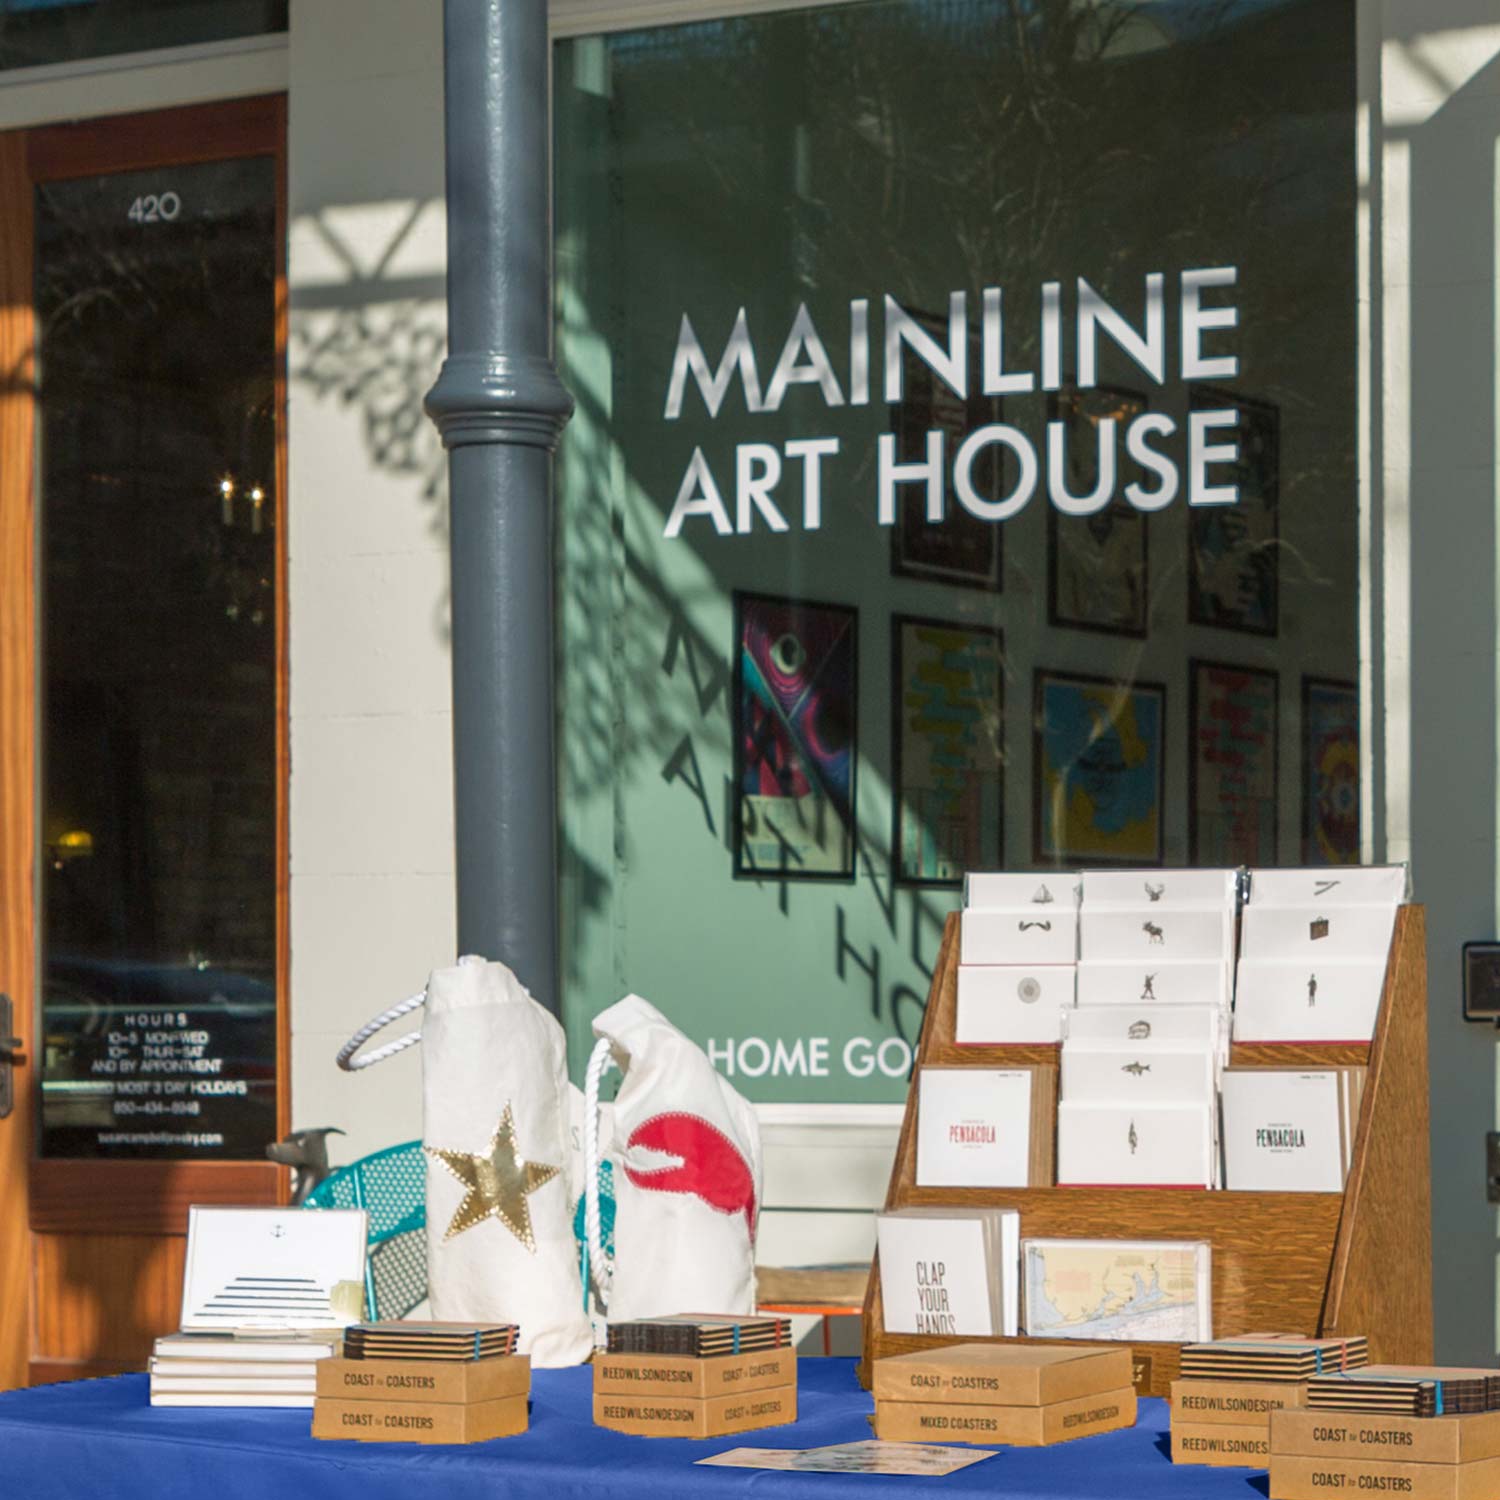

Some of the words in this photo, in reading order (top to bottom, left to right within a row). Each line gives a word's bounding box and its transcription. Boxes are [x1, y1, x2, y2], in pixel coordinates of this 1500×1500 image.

[127, 191, 181, 222] 420
[664, 266, 1238, 419] MAINLINE
[664, 438, 839, 538] ART
[877, 409, 1239, 525] HOUSE
[124, 1012, 188, 1028] HOURS
[91, 1060, 117, 1073] AND
[119, 1060, 137, 1073] BY
[140, 1058, 222, 1073] APPOINTMENT
[708, 1036, 829, 1077] HOME
[843, 1036, 920, 1078] GO
[117, 1081, 150, 1095] MOST
[164, 1081, 187, 1095] DAY
[190, 1080, 248, 1096] HOLIDAYS
[949, 1125, 996, 1144] PENSACOLA
[1256, 1128, 1306, 1148] PENSACOLA
[916, 1261, 945, 1287] CLAP
[917, 1287, 950, 1312] YOUR
[916, 1313, 956, 1336] HANDS
[343, 1372, 375, 1386] COAST
[386, 1374, 436, 1389] COASTERS
[602, 1366, 694, 1384] REEDWILSONDESIGN
[722, 1367, 744, 1383] COAST
[749, 1362, 780, 1377] COASTERS
[910, 1374, 941, 1388] COAST
[951, 1376, 1000, 1391] COASTERS
[724, 1406, 745, 1421] COAST
[751, 1401, 782, 1417] COASTERS
[1181, 1395, 1285, 1413] REEDWILSONDESIGN
[341, 1412, 374, 1426] COAST
[384, 1415, 434, 1429] COASTERS
[603, 1405, 695, 1423] REEDWILSONDESIGN
[920, 1415, 949, 1429] MIXED
[950, 1417, 998, 1431] COASTERS
[1062, 1405, 1120, 1429] REEDWILSONDESIGN
[1312, 1427, 1348, 1443] COAST
[1359, 1430, 1413, 1446] COASTERS
[1311, 1472, 1346, 1488] COAST
[1358, 1475, 1412, 1492] COASTERS
